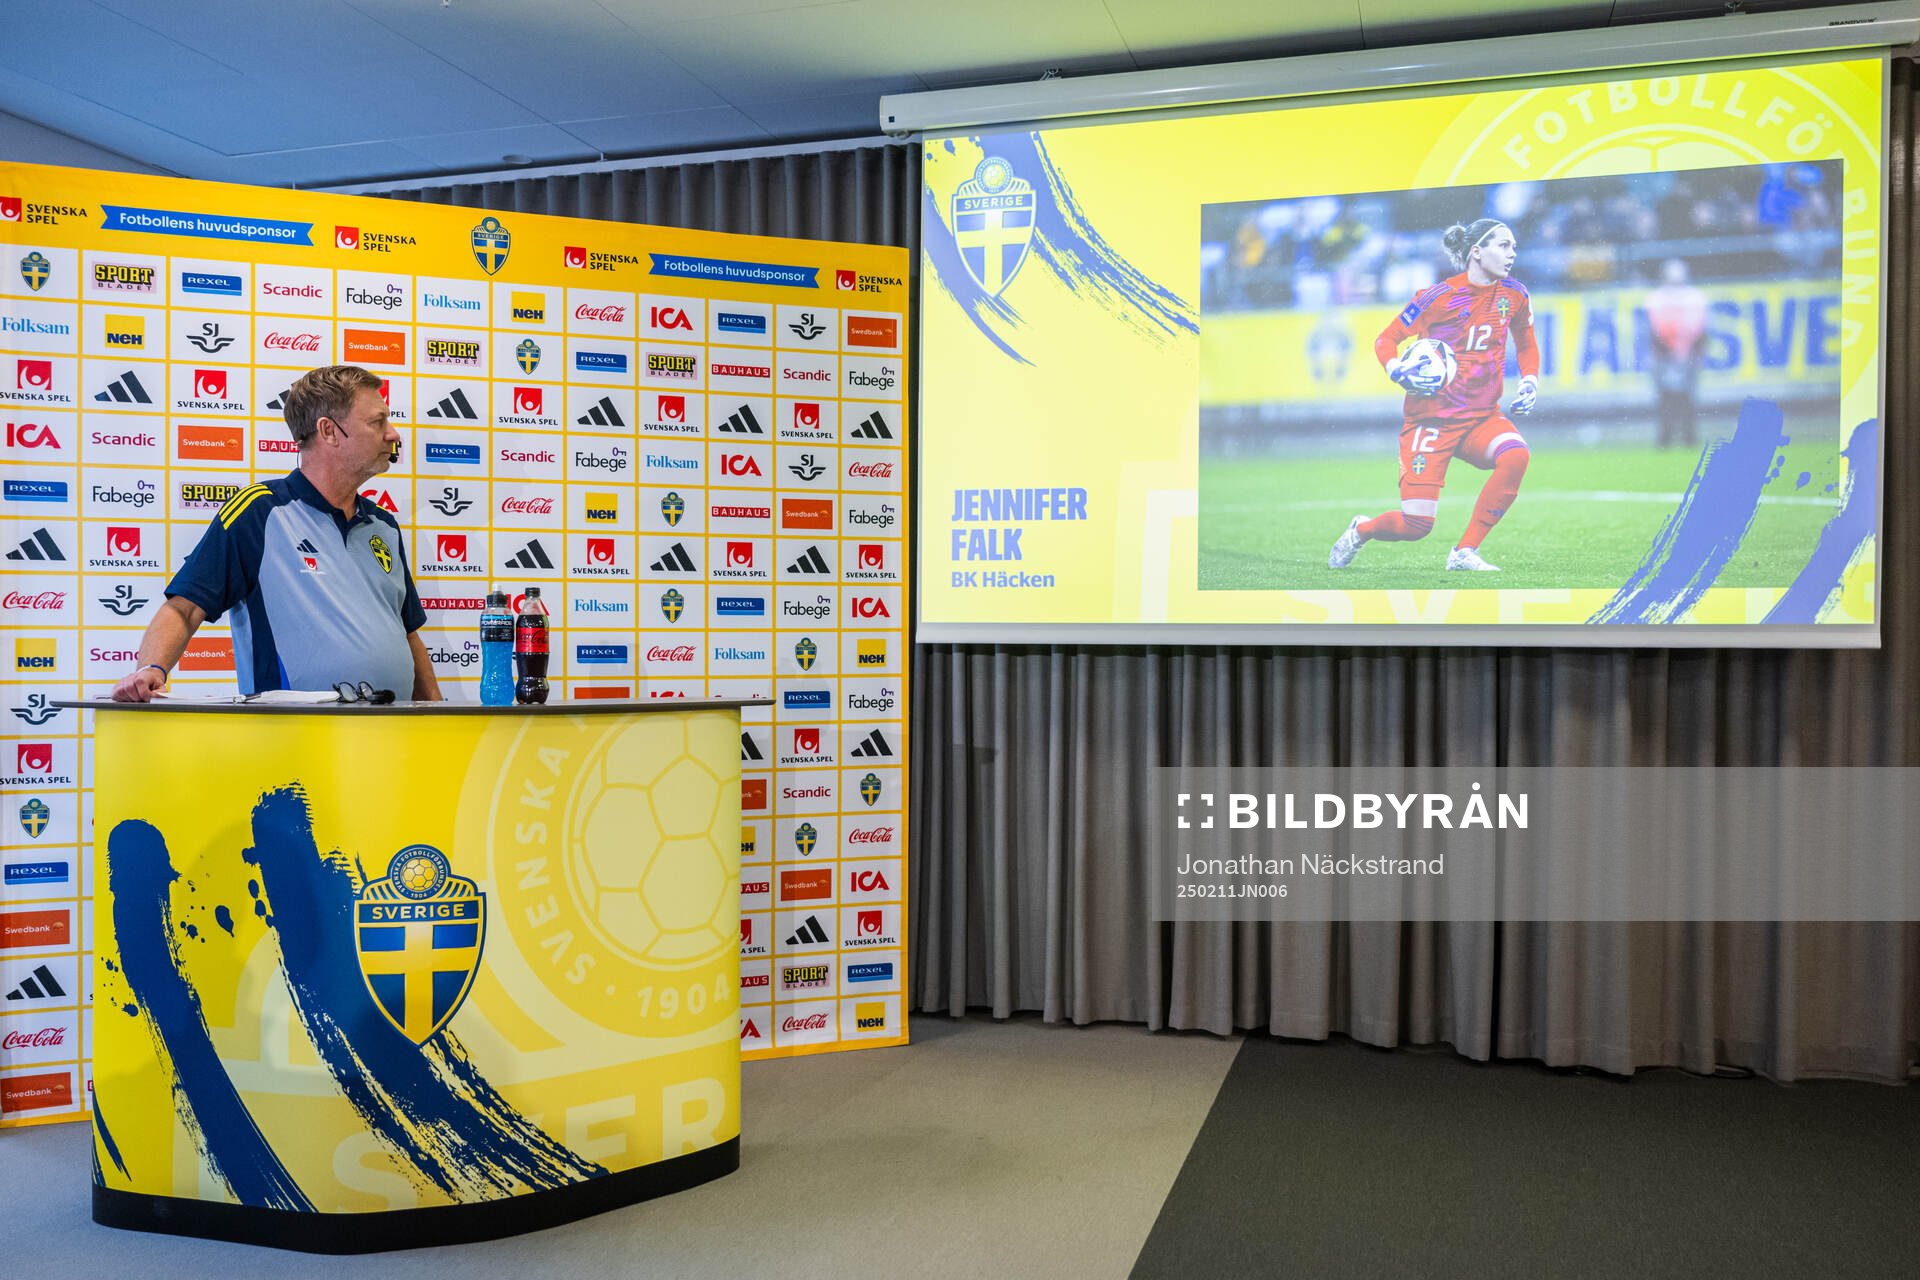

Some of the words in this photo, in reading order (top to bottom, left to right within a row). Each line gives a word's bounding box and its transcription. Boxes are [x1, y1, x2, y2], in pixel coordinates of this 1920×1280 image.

[26, 203, 88, 217] SVENSKA
[964, 196, 1024, 210] SVERIGE
[26, 214, 59, 225] SPEL
[120, 212, 194, 230] Fotbollens
[197, 214, 297, 238] huvudsponsor
[363, 232, 417, 246] SVENSKA
[363, 242, 391, 253] SPEL
[590, 252, 639, 265] SVENSKA
[590, 261, 616, 272] SPEL
[664, 260, 724, 275] Fotbollens
[726, 265, 805, 282] huvudsponsor
[95, 263, 154, 285] SPORT
[859, 275, 903, 286] SVENSKA
[98, 282, 152, 291] BLADET
[263, 282, 323, 298] Scandic
[859, 283, 882, 293] SPEL
[346, 287, 402, 310] Fabege
[423, 293, 481, 311] Folksam
[2, 316, 70, 335] Folksam
[651, 306, 693, 331] ICA
[800, 313, 815, 326] SJ
[202, 322, 219, 337] SJ
[851, 328, 883, 336] Swedbank
[1466, 325, 1492, 351] 12
[348, 342, 389, 351] Swedbank
[427, 340, 479, 359] SPORT
[430, 357, 478, 365] BLADET
[648, 355, 695, 372] SPORT
[651, 370, 694, 378] BLADET
[712, 365, 769, 377] BAUHAUS
[783, 368, 831, 382] Scandic
[849, 371, 894, 391] Fabege
[0, 391, 44, 401] SVENSKA
[48, 393, 71, 402] SPEL
[177, 400, 220, 409] SVENSKA
[223, 402, 245, 410] SPEL
[389, 410, 406, 418] PEL
[499, 416, 536, 425] SVENSKA
[539, 418, 558, 426] SPEL
[644, 423, 679, 432] SVENSKA
[681, 425, 700, 433] SPEL
[781, 430, 814, 438] SVENSKA
[816, 431, 834, 439] SPEL
[7, 422, 61, 449] ICA
[92, 432, 156, 447] Scandic
[1411, 426, 1439, 452] 12
[182, 438, 226, 448] Swedbank
[260, 441, 300, 452] BAUH
[501, 449, 556, 463] Scandic
[575, 452, 627, 472] Fabege
[646, 454, 699, 470] Folksam
[800, 454, 814, 467] SJ
[721, 454, 762, 476] ICA
[92, 486, 155, 508] Fabege
[443, 487, 459, 501] SJ
[951, 487, 1088, 521] JENNIFER
[712, 507, 769, 518] BAUHAUS
[785, 510, 819, 518] Swedbank
[849, 509, 894, 528] Fabege
[951, 528, 1022, 561] FALK
[90, 559, 134, 567] SVENSKA
[137, 559, 160, 568] SPEL
[421, 564, 461, 572] SVENSKA
[463, 565, 483, 573] SPEL
[713, 569, 747, 577] SVENSKA
[951, 571, 978, 587] BK
[982, 571, 1055, 587] Häcken
[115, 585, 132, 599] SJ
[421, 599, 485, 609] BAUHAUS
[575, 598, 629, 612] Folksam
[783, 601, 831, 620] Fabege
[851, 597, 890, 618] ICA
[90, 648, 139, 662] Scan
[183, 650, 226, 658] Swedbank
[715, 647, 765, 660] Folksam
[28, 693, 46, 708] SJ
[849, 694, 894, 712] Fabege
[781, 756, 814, 764] SVENSKA
[816, 755, 834, 763] SPEL
[0, 776, 44, 785] SVENSKA
[47, 776, 71, 784] SPEL
[783, 786, 831, 799] Scandic
[784, 881, 818, 889] Swedbank
[851, 871, 890, 892] ICA
[372, 903, 465, 920] SVERIGE
[4, 924, 50, 935] Swedbank
[844, 938, 878, 946] SVENSKA
[784, 966, 828, 984] SPORT
[786, 981, 827, 989] BLADET
[637, 972, 731, 1019] 1904
[6, 1087, 52, 1099] Swedbank
